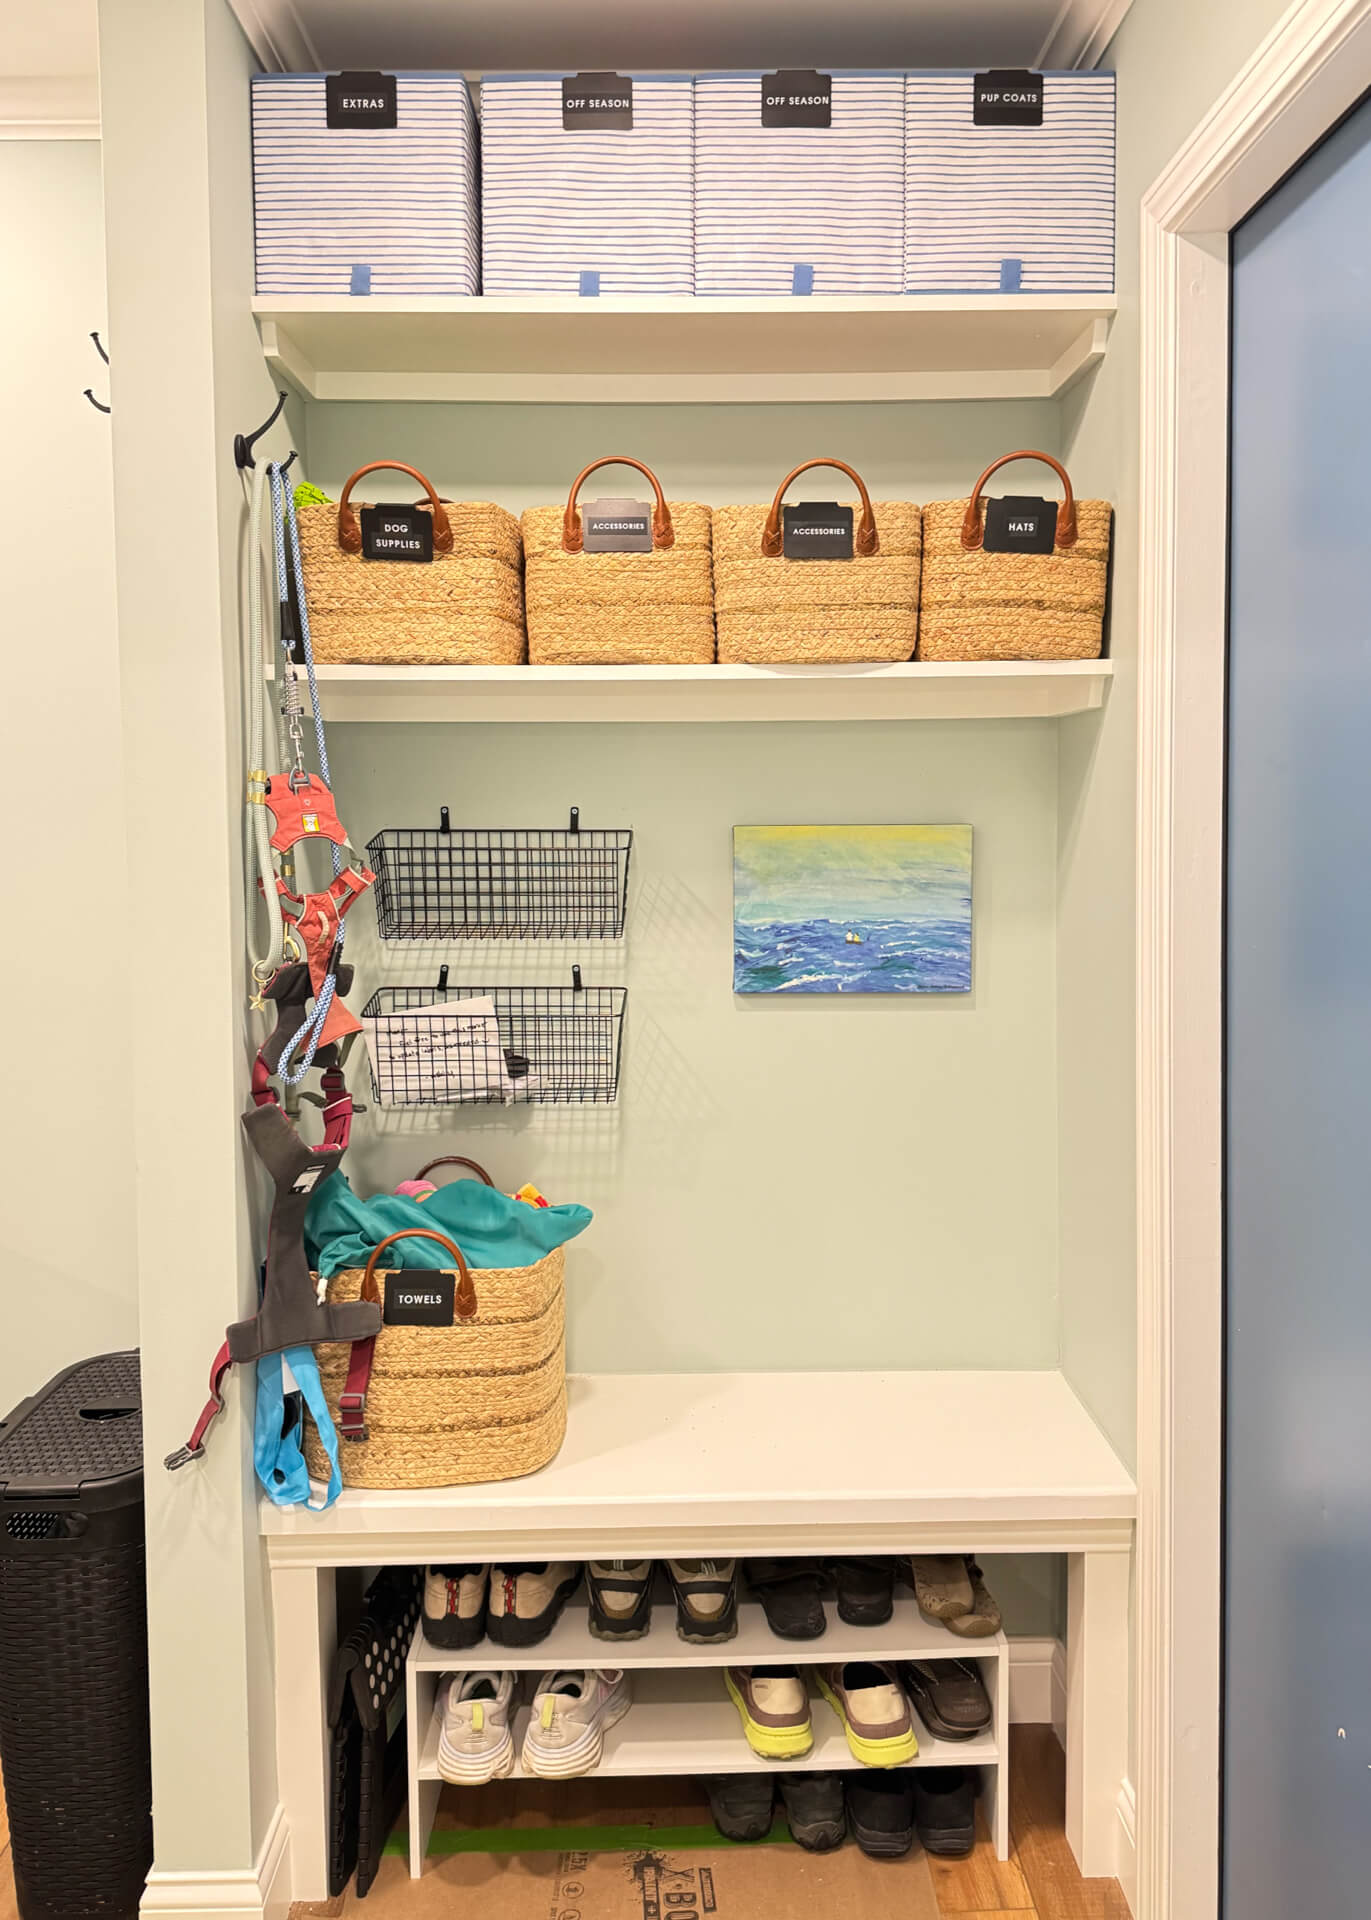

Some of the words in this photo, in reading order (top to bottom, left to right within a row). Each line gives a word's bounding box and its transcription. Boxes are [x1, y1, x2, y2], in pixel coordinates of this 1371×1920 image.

[766, 96, 786, 106] OFF
[788, 95, 830, 106] SEASON
[980, 93, 1000, 103] PUP
[1002, 93, 1038, 103] COATS
[342, 98, 385, 109] EXTRAS
[566, 99, 586, 109] OFF
[588, 98, 630, 109] SEASON
[383, 524, 409, 534] DOG
[592, 522, 645, 531] ACCESSORIES
[792, 527, 846, 536] ACCESSORIES
[1008, 522, 1035, 532] HATS
[375, 538, 422, 550] SUPPLIES
[398, 1294, 443, 1305] TOWELS
